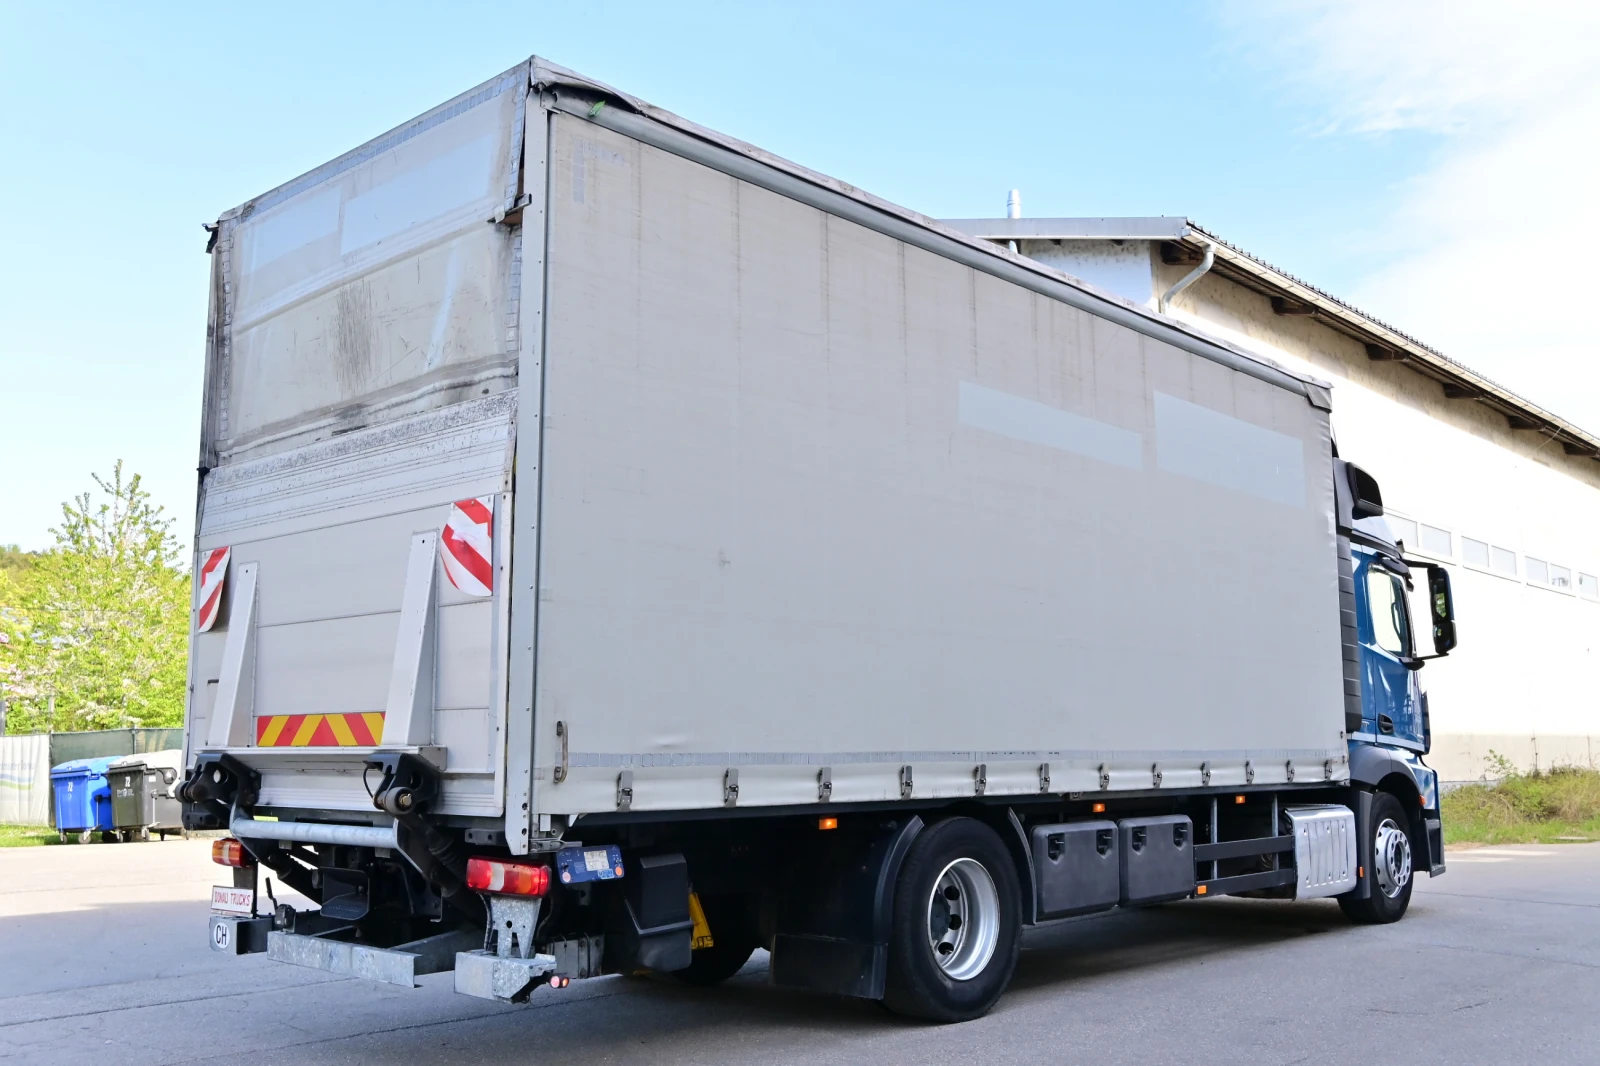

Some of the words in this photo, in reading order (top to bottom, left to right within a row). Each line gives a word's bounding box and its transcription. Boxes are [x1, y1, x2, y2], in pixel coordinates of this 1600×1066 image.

[214, 891, 228, 904] DONAU
[230, 892, 250, 906] TRUCKS
[216, 925, 227, 945] CH
